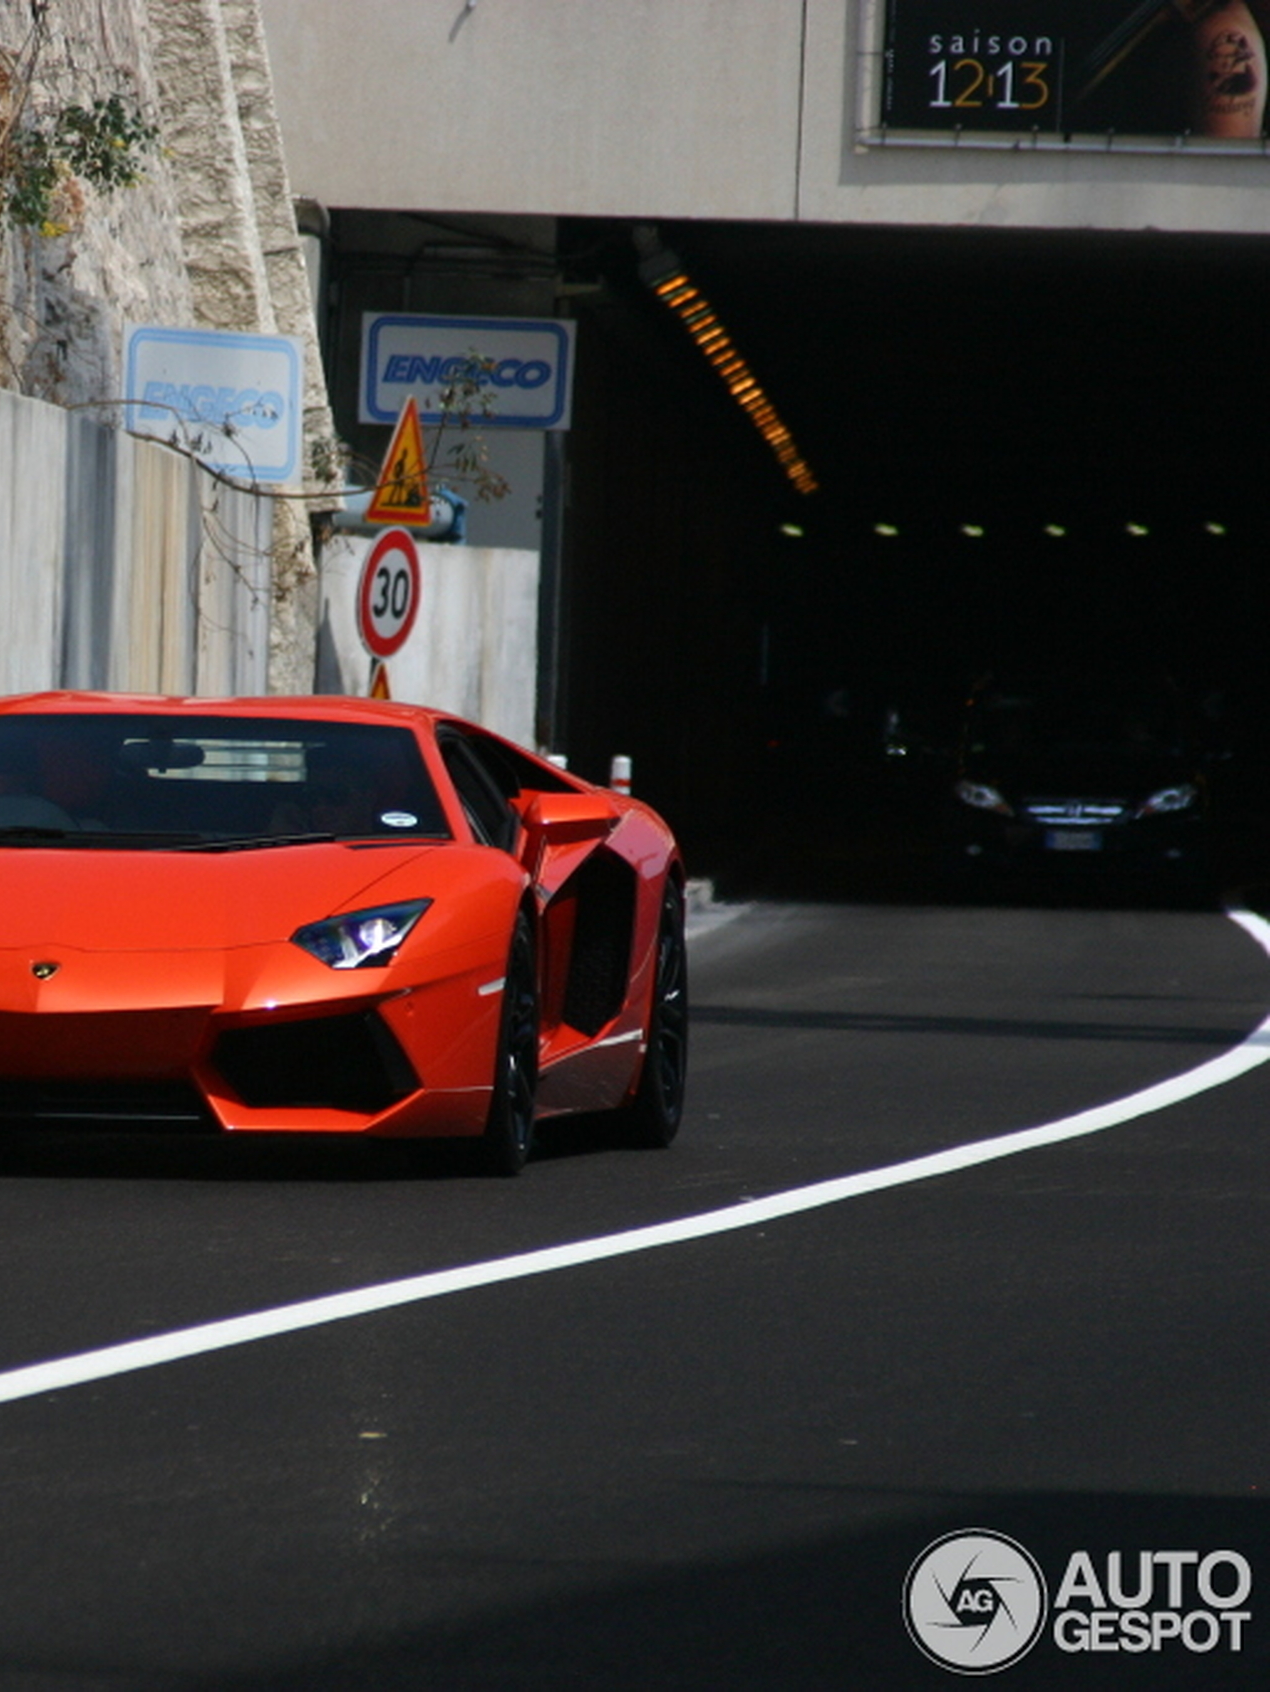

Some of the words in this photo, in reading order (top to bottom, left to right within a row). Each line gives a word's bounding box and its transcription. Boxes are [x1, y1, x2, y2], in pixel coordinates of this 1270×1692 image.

[929, 28, 1052, 56] saison
[138, 380, 285, 430] ENGECO
[372, 566, 410, 619] 30
